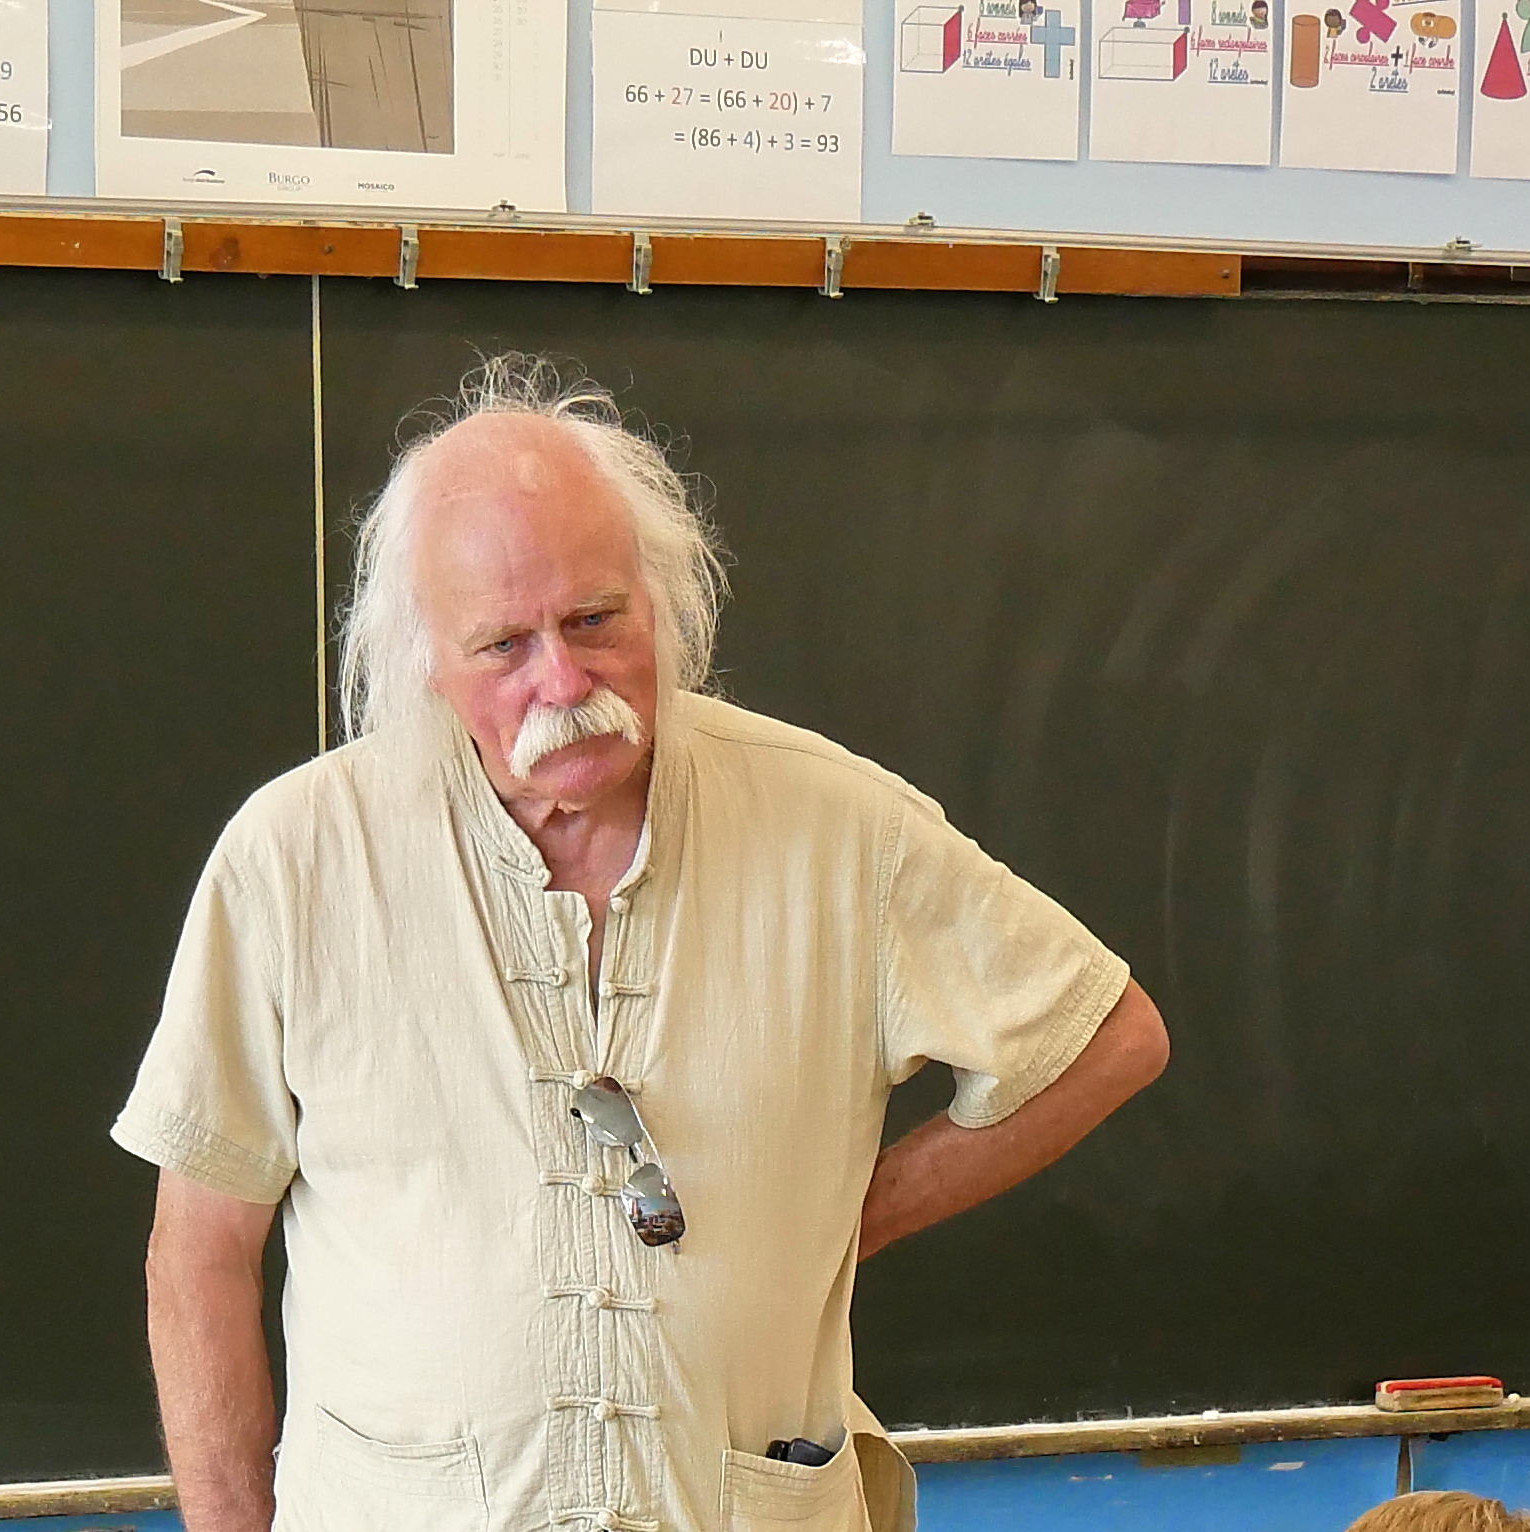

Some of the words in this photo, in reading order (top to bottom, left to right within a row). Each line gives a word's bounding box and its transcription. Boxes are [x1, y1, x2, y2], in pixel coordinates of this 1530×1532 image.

[689, 48, 717, 67] DU
[723, 54, 735, 66] +
[740, 50, 769, 70] DU
[1391, 46, 1403, 67] +
[0, 61, 13, 80] 9
[625, 84, 649, 104] 66
[671, 87, 694, 106] 27
[717, 88, 747, 112] (66
[769, 91, 798, 115] 20)
[821, 95, 832, 113] 7
[691, 127, 721, 151] (86
[743, 129, 762, 154] 4)
[784, 133, 794, 151] 3
[817, 135, 840, 153] 93
[268, 171, 311, 185] BURGO
[357, 182, 395, 191] MOSAICO
